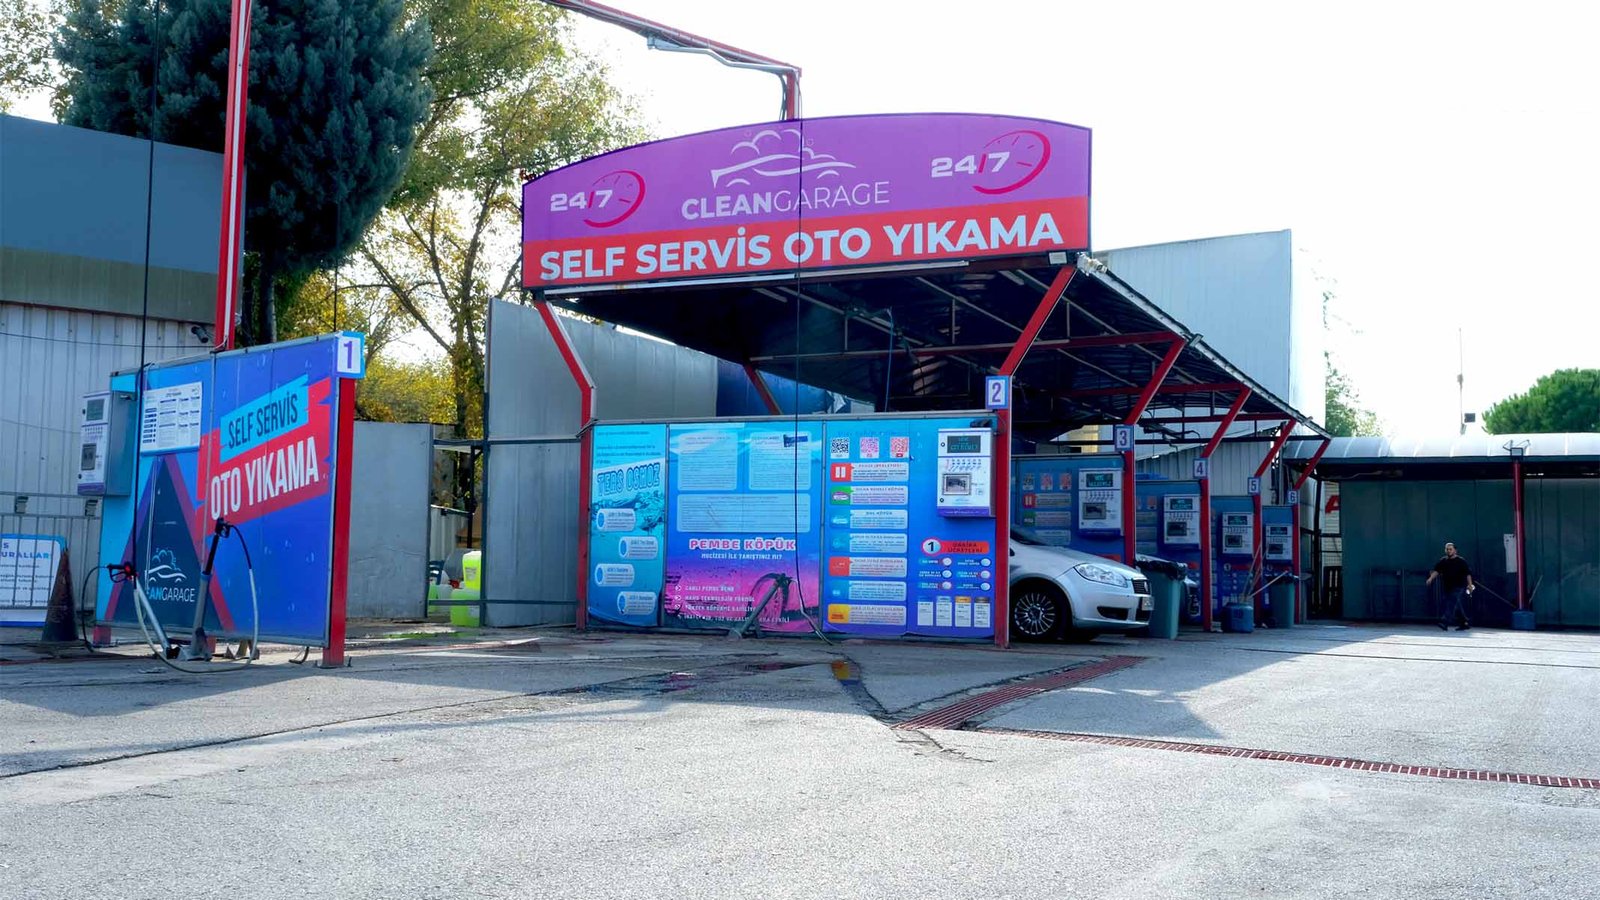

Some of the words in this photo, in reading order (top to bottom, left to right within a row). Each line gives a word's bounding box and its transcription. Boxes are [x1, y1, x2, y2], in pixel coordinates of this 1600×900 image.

[931, 152, 1010, 178] 24/7
[550, 189, 613, 212] 24/7
[681, 181, 890, 220] CLEANGARAGE
[540, 246, 626, 281] SELF
[636, 226, 771, 274] SERVİS
[783, 227, 871, 263] OTO
[883, 212, 1064, 256] YIKAMA
[343, 340, 353, 369] 1
[992, 382, 1001, 402] 2
[228, 410, 254, 449] SELF
[256, 391, 298, 437] SERVİS
[1119, 431, 1126, 445] 3
[211, 467, 241, 521] OTO
[244, 436, 319, 506] YIKAMA
[1196, 463, 1204, 474] 4
[1251, 480, 1257, 492] 5
[689, 538, 740, 551] PEMBE
[743, 537, 796, 551] KÖPÜK
[927, 541, 934, 552] 1
[0, 551, 50, 559] URALLAR
[149, 587, 195, 602] ANGARAGE
